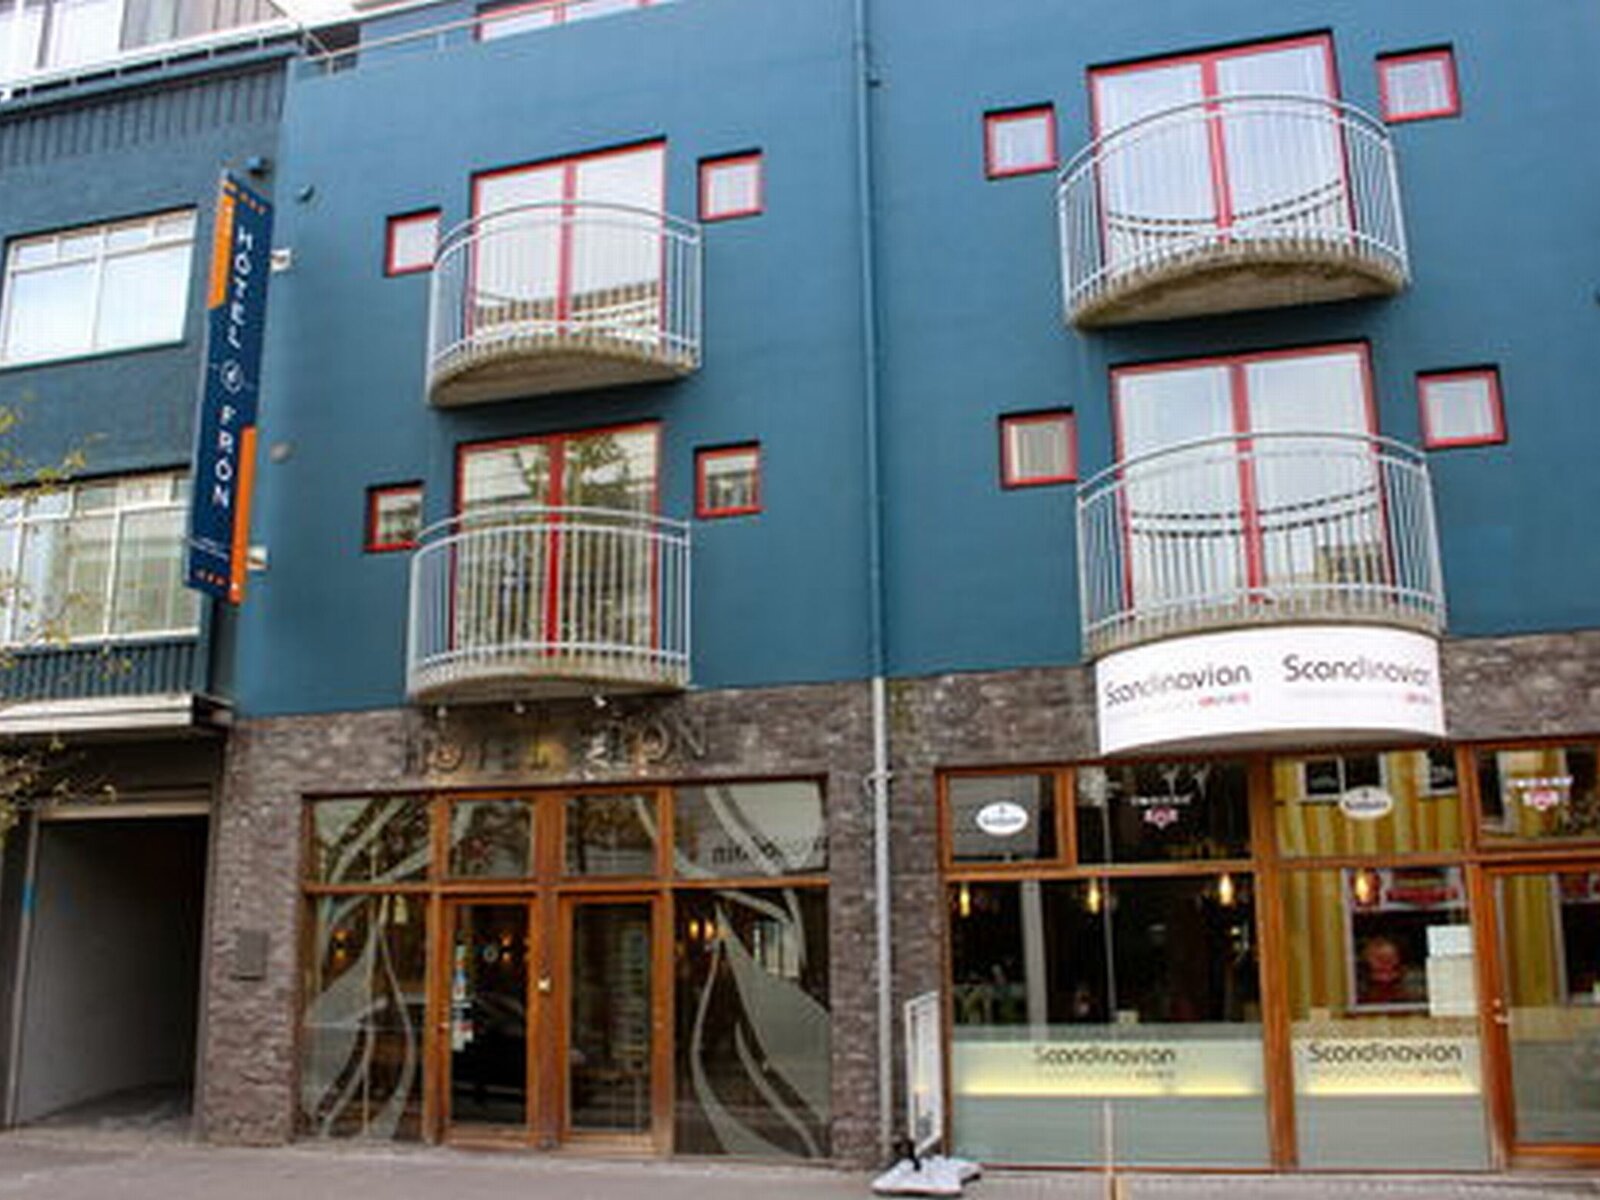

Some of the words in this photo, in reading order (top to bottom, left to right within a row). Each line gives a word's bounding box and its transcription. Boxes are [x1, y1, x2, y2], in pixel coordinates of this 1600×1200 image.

[228, 225, 253, 349] HOTEL
[1104, 663, 1252, 707] Scandinavian
[1034, 1045, 1176, 1066] Scandinavian
[1308, 1043, 1463, 1063] Scandinavian
